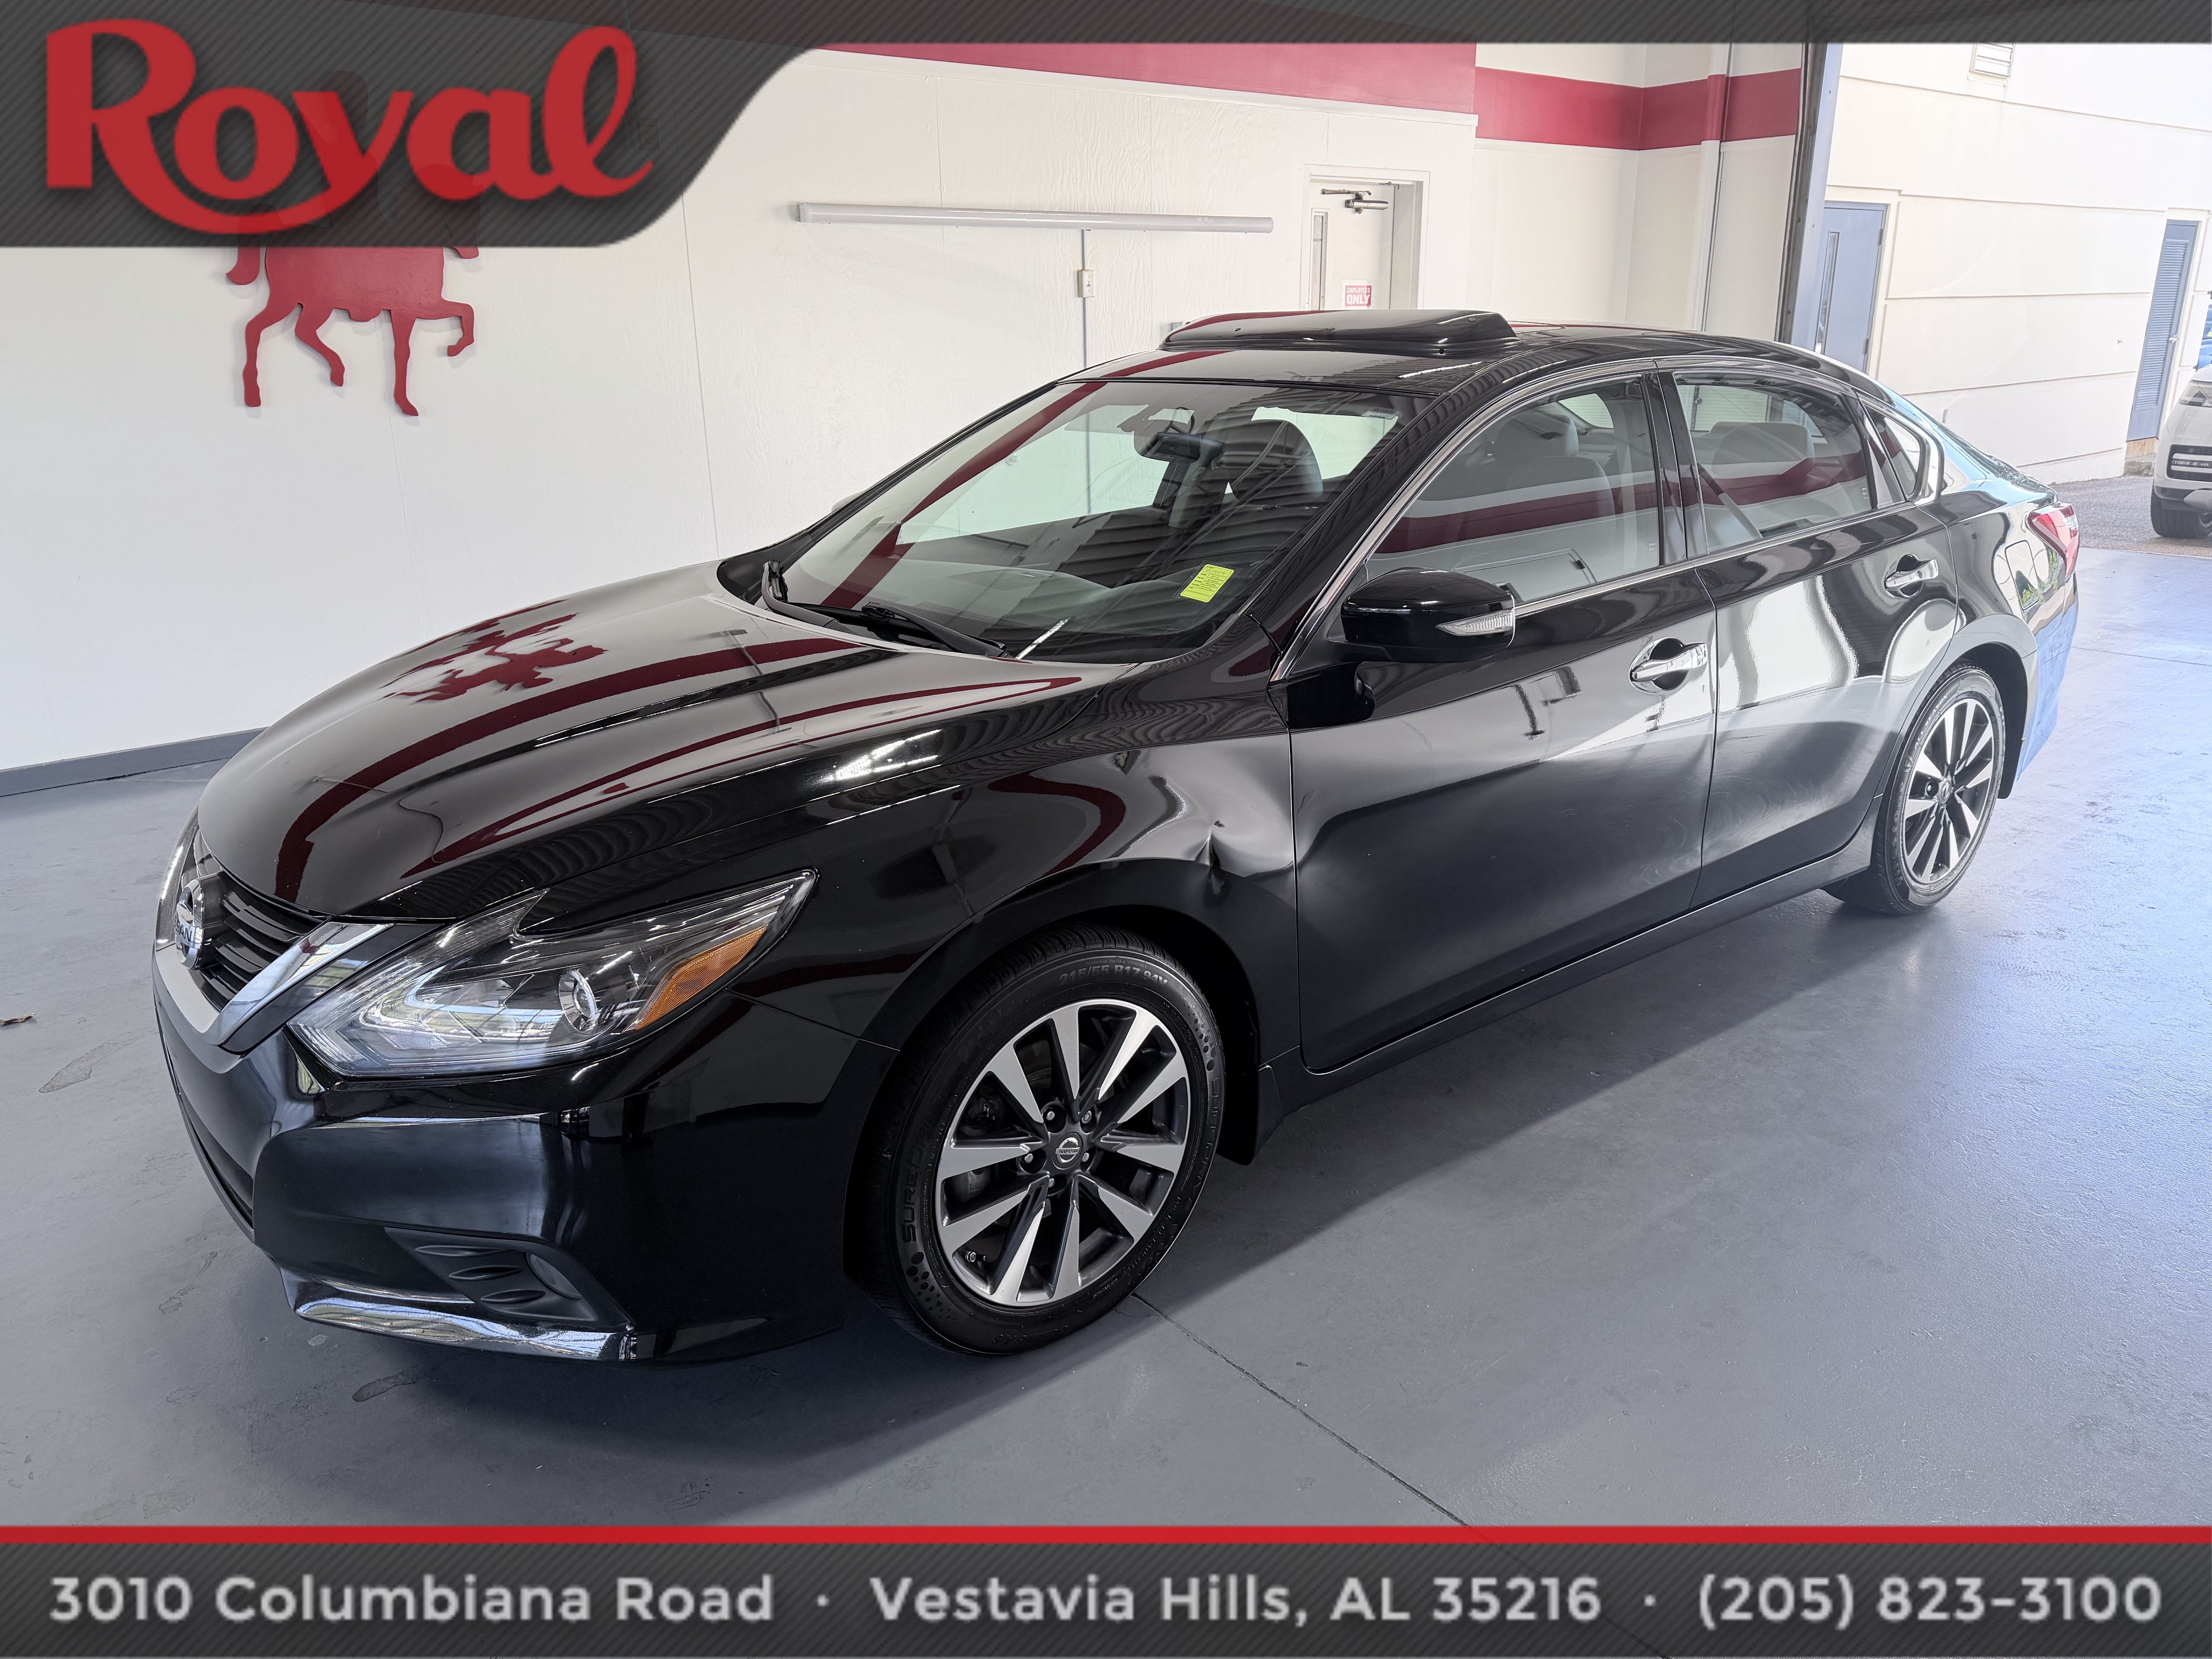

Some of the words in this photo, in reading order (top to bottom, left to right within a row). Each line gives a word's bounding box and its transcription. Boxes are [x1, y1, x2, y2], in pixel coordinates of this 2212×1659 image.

[1346, 294, 1370, 305] ONLY
[1059, 965, 1109, 986] 215/55
[1114, 964, 1141, 978] R17
[1143, 970, 1169, 986] 94V
